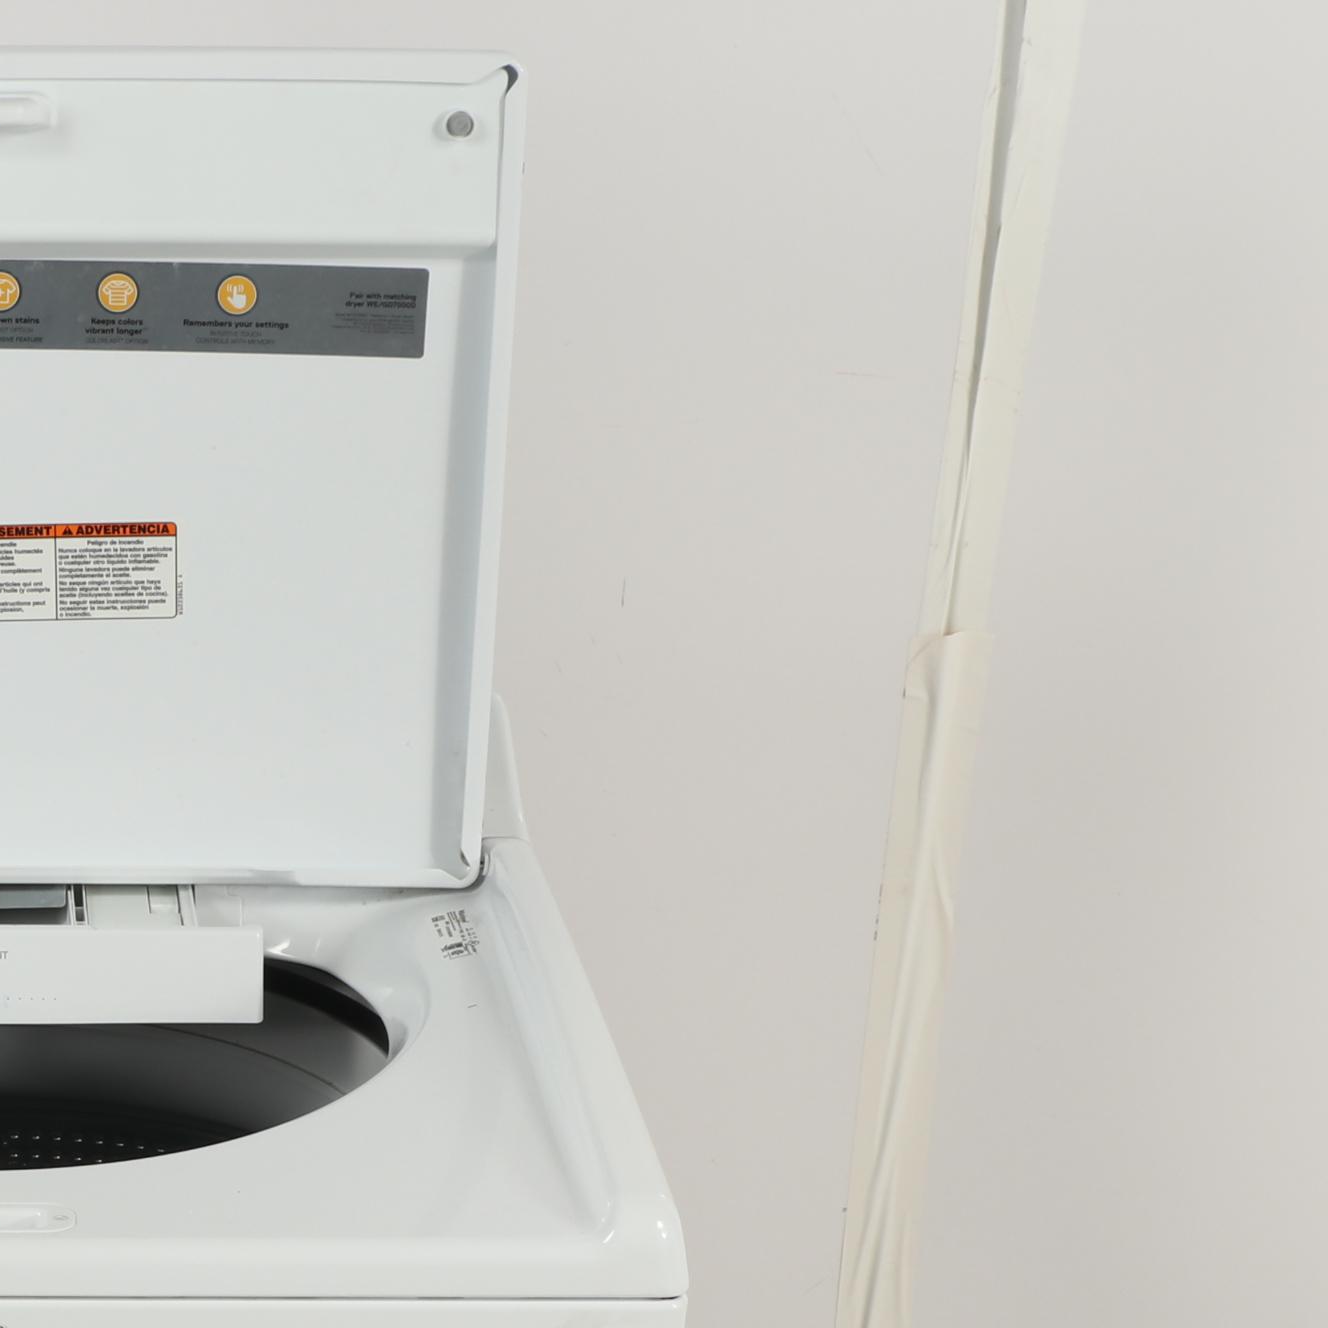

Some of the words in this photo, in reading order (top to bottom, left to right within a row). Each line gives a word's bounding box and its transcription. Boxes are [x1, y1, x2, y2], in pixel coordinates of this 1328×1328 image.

[383, 293, 416, 301] matching
[15, 316, 40, 324] stains
[91, 318, 115, 326] Keeps
[183, 319, 232, 327] Remembers
[235, 321, 253, 329] your
[256, 320, 289, 329] settings
[85, 327, 114, 335] vibrant
[76, 525, 169, 535] ADVERTENCIA
